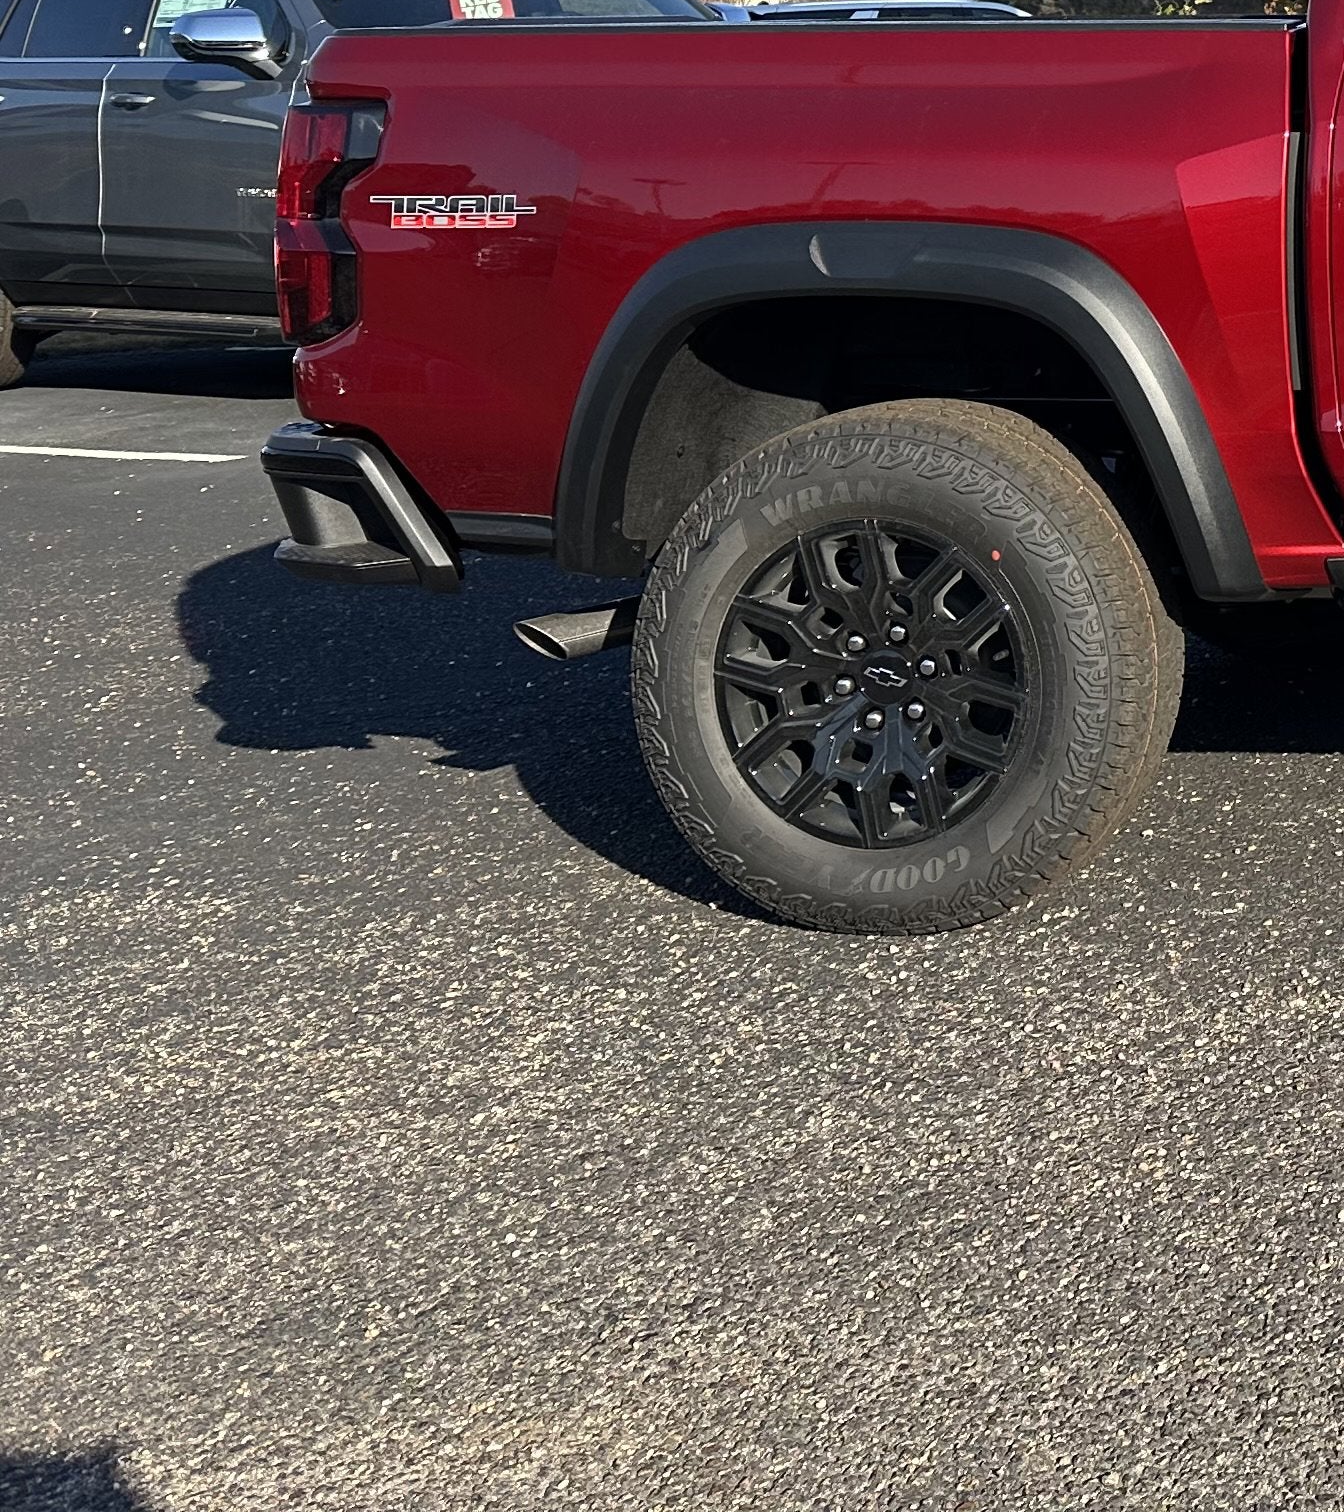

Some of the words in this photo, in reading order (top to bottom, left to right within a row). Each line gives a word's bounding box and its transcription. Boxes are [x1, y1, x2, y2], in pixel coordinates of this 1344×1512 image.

[461, 3, 503, 19] TAG
[369, 194, 537, 215] TRAIL
[390, 213, 517, 229] BOSS
